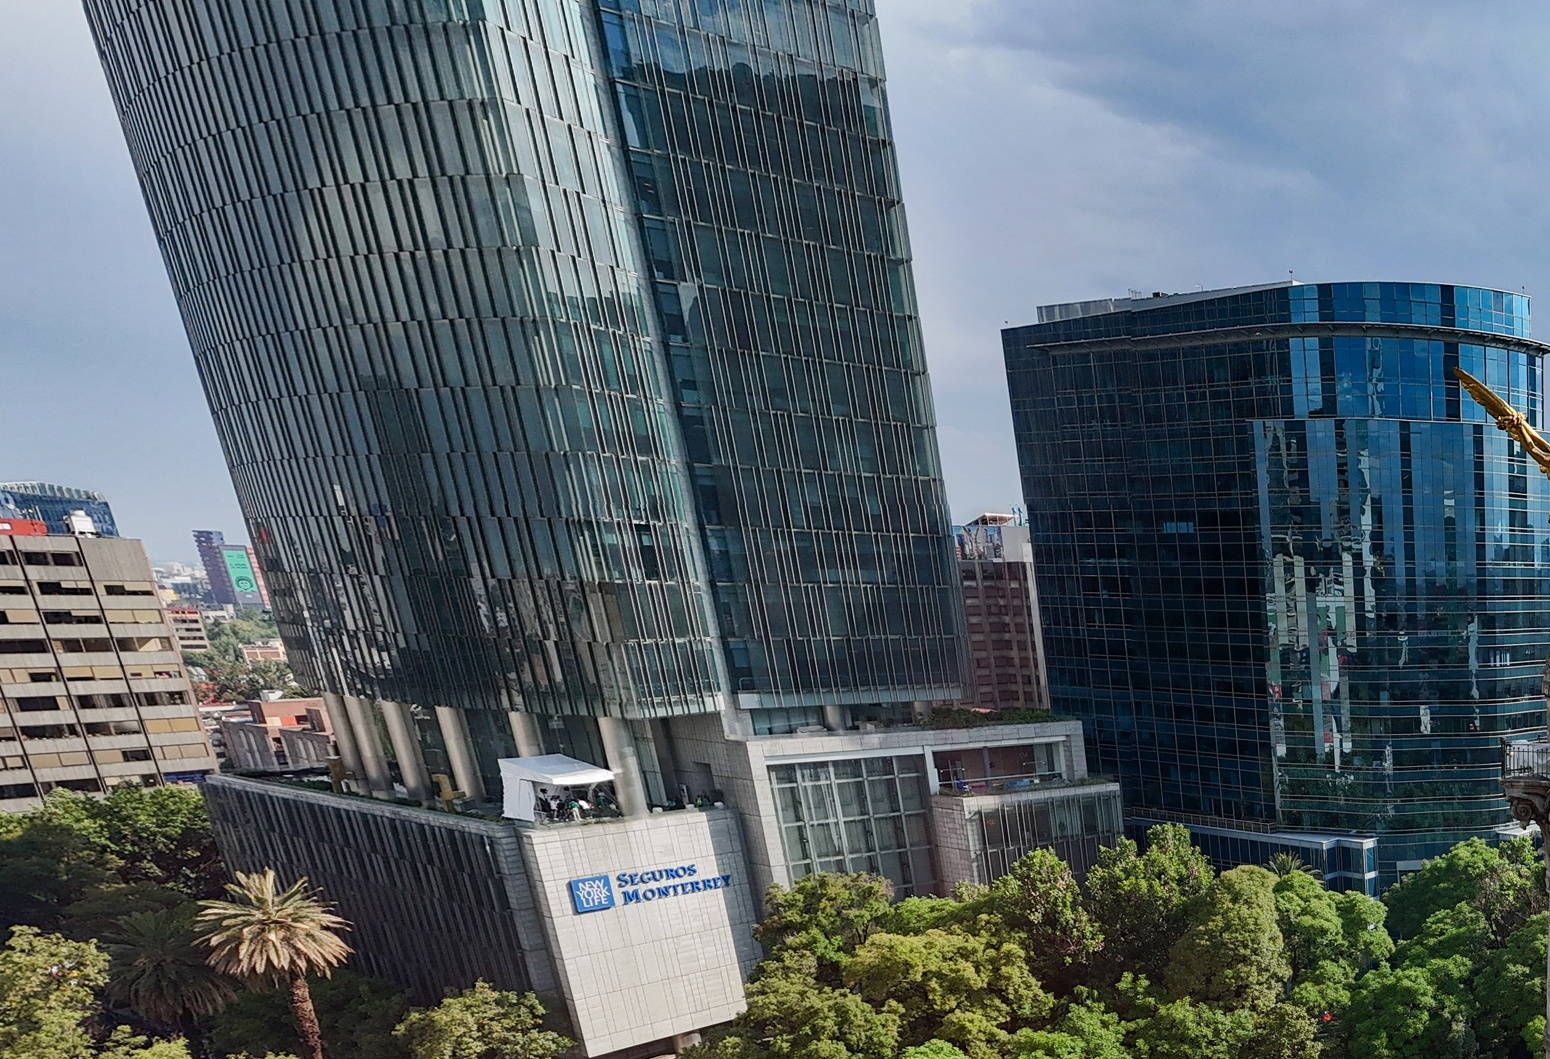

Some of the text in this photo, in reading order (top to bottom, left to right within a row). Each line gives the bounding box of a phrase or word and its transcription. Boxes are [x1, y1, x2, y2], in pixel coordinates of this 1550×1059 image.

[616, 863, 698, 889] SEGUROS
[578, 879, 605, 892] NEW
[622, 873, 733, 906] MONTERREY
[576, 886, 611, 900] YORK
[582, 896, 609, 908] LIFE
